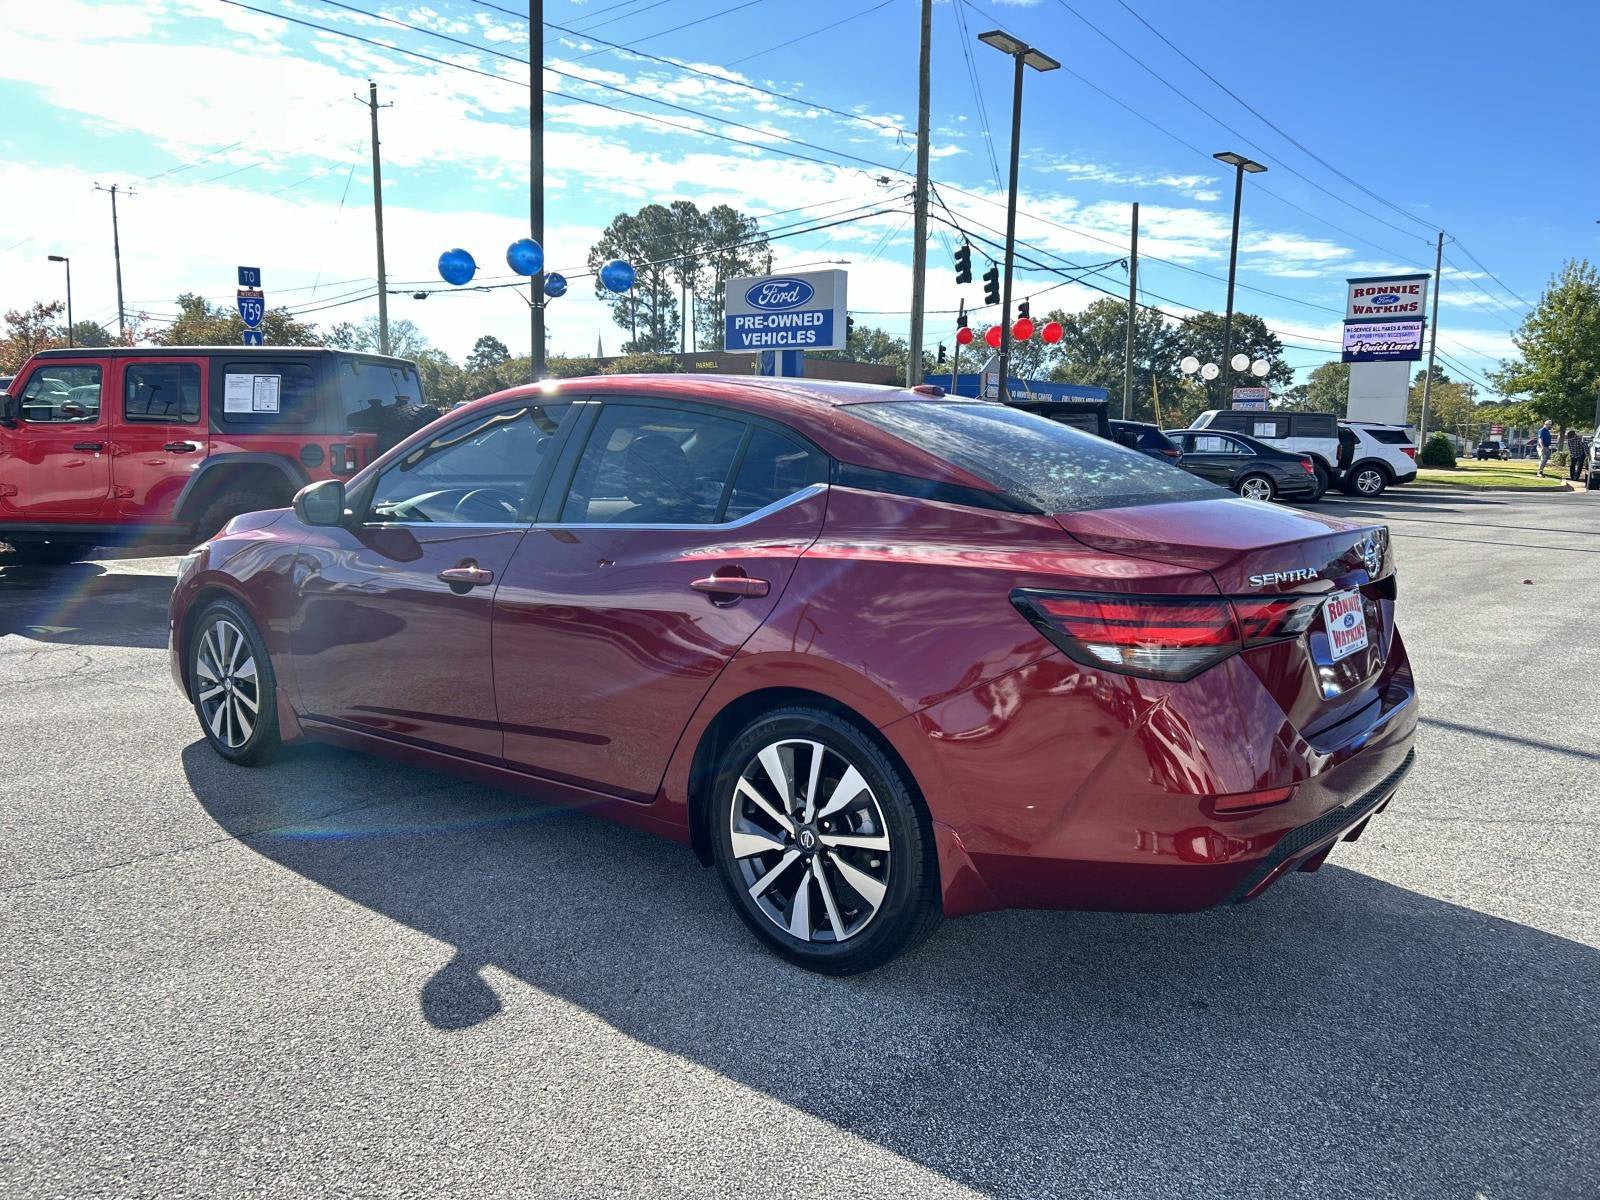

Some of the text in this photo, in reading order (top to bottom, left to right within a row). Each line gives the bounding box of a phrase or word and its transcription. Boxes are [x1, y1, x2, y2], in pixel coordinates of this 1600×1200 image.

[243, 271, 255, 282] TO
[758, 282, 800, 305] Ford
[1354, 285, 1420, 298] RONNIE
[241, 303, 261, 320] 759
[1353, 302, 1418, 314] WATKINS
[735, 312, 824, 330] PRE-OWNED
[742, 330, 816, 346] VEHICLES
[1361, 342, 1414, 352] Quick Lane
[695, 361, 719, 369] PARNELL
[1249, 567, 1319, 587] SENTRA
[1327, 594, 1362, 622] RONNIE
[1331, 622, 1365, 649] WATKINS
